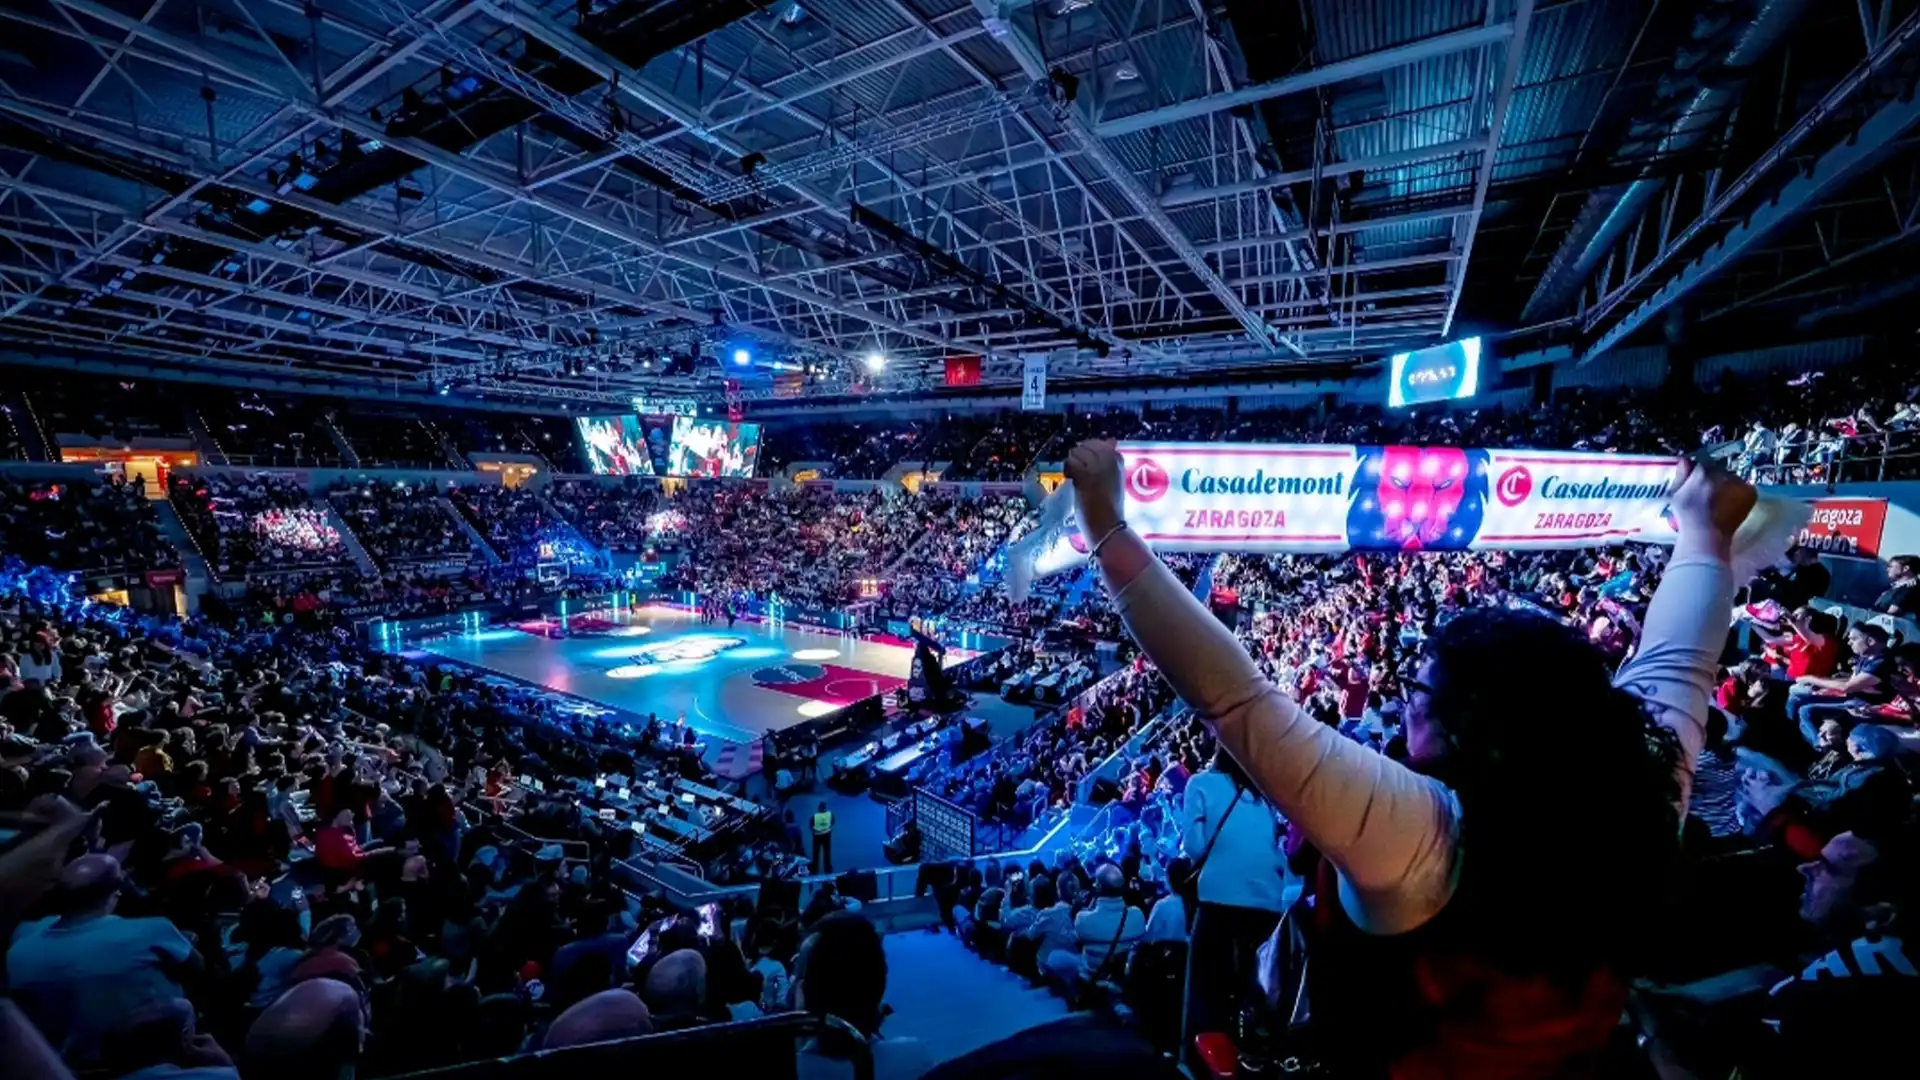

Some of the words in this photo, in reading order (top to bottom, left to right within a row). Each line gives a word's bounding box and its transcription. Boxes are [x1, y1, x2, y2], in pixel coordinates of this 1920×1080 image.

[1031, 376, 1038, 392] 4
[1181, 467, 1345, 496] Casademont
[1184, 510, 1286, 529] ZARAGOZA
[1534, 512, 1613, 529] ZARAGOZA
